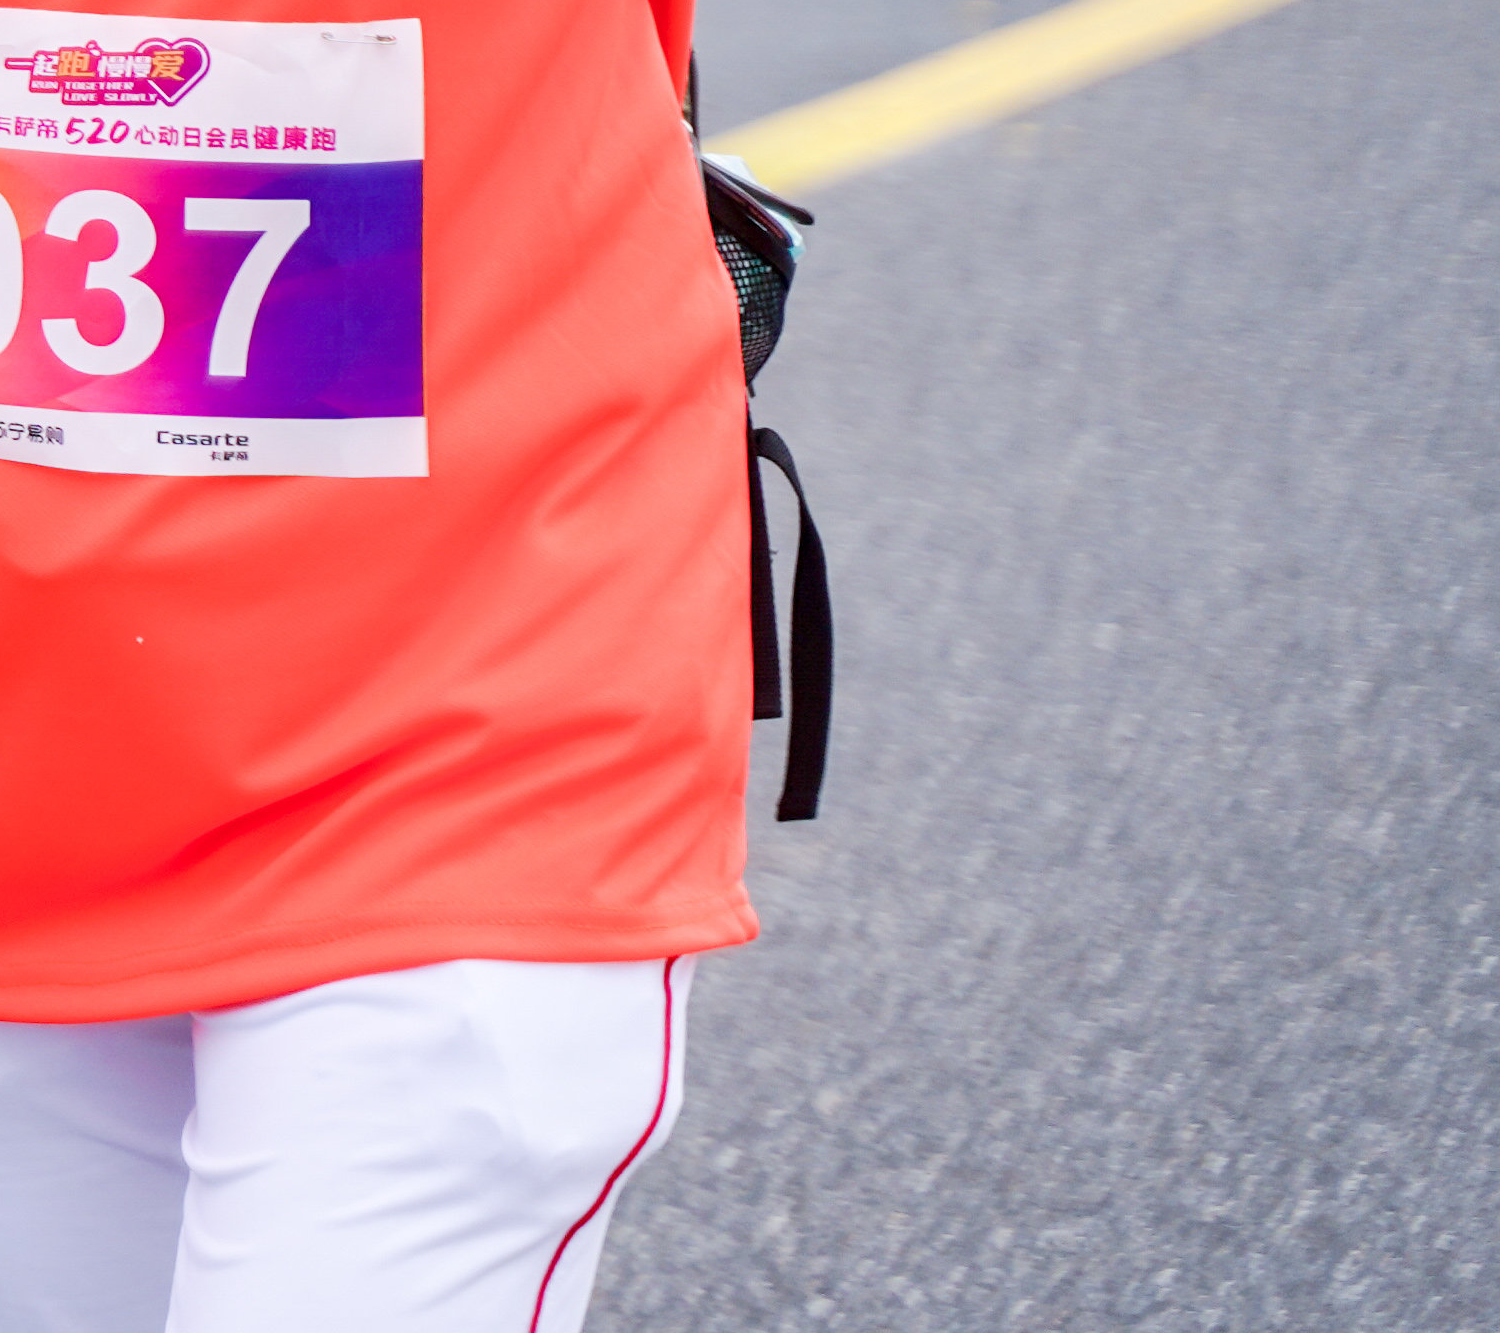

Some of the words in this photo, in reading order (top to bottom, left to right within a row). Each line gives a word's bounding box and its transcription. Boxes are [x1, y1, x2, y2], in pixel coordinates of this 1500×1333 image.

[8, 51, 185, 81] 一起跑慢慢爱
[31, 80, 59, 90] RUN
[65, 81, 135, 91] TOGETHER
[64, 93, 98, 102] LOVE
[104, 93, 158, 102] SLOWLY
[156, 431, 249, 447] Casarte
